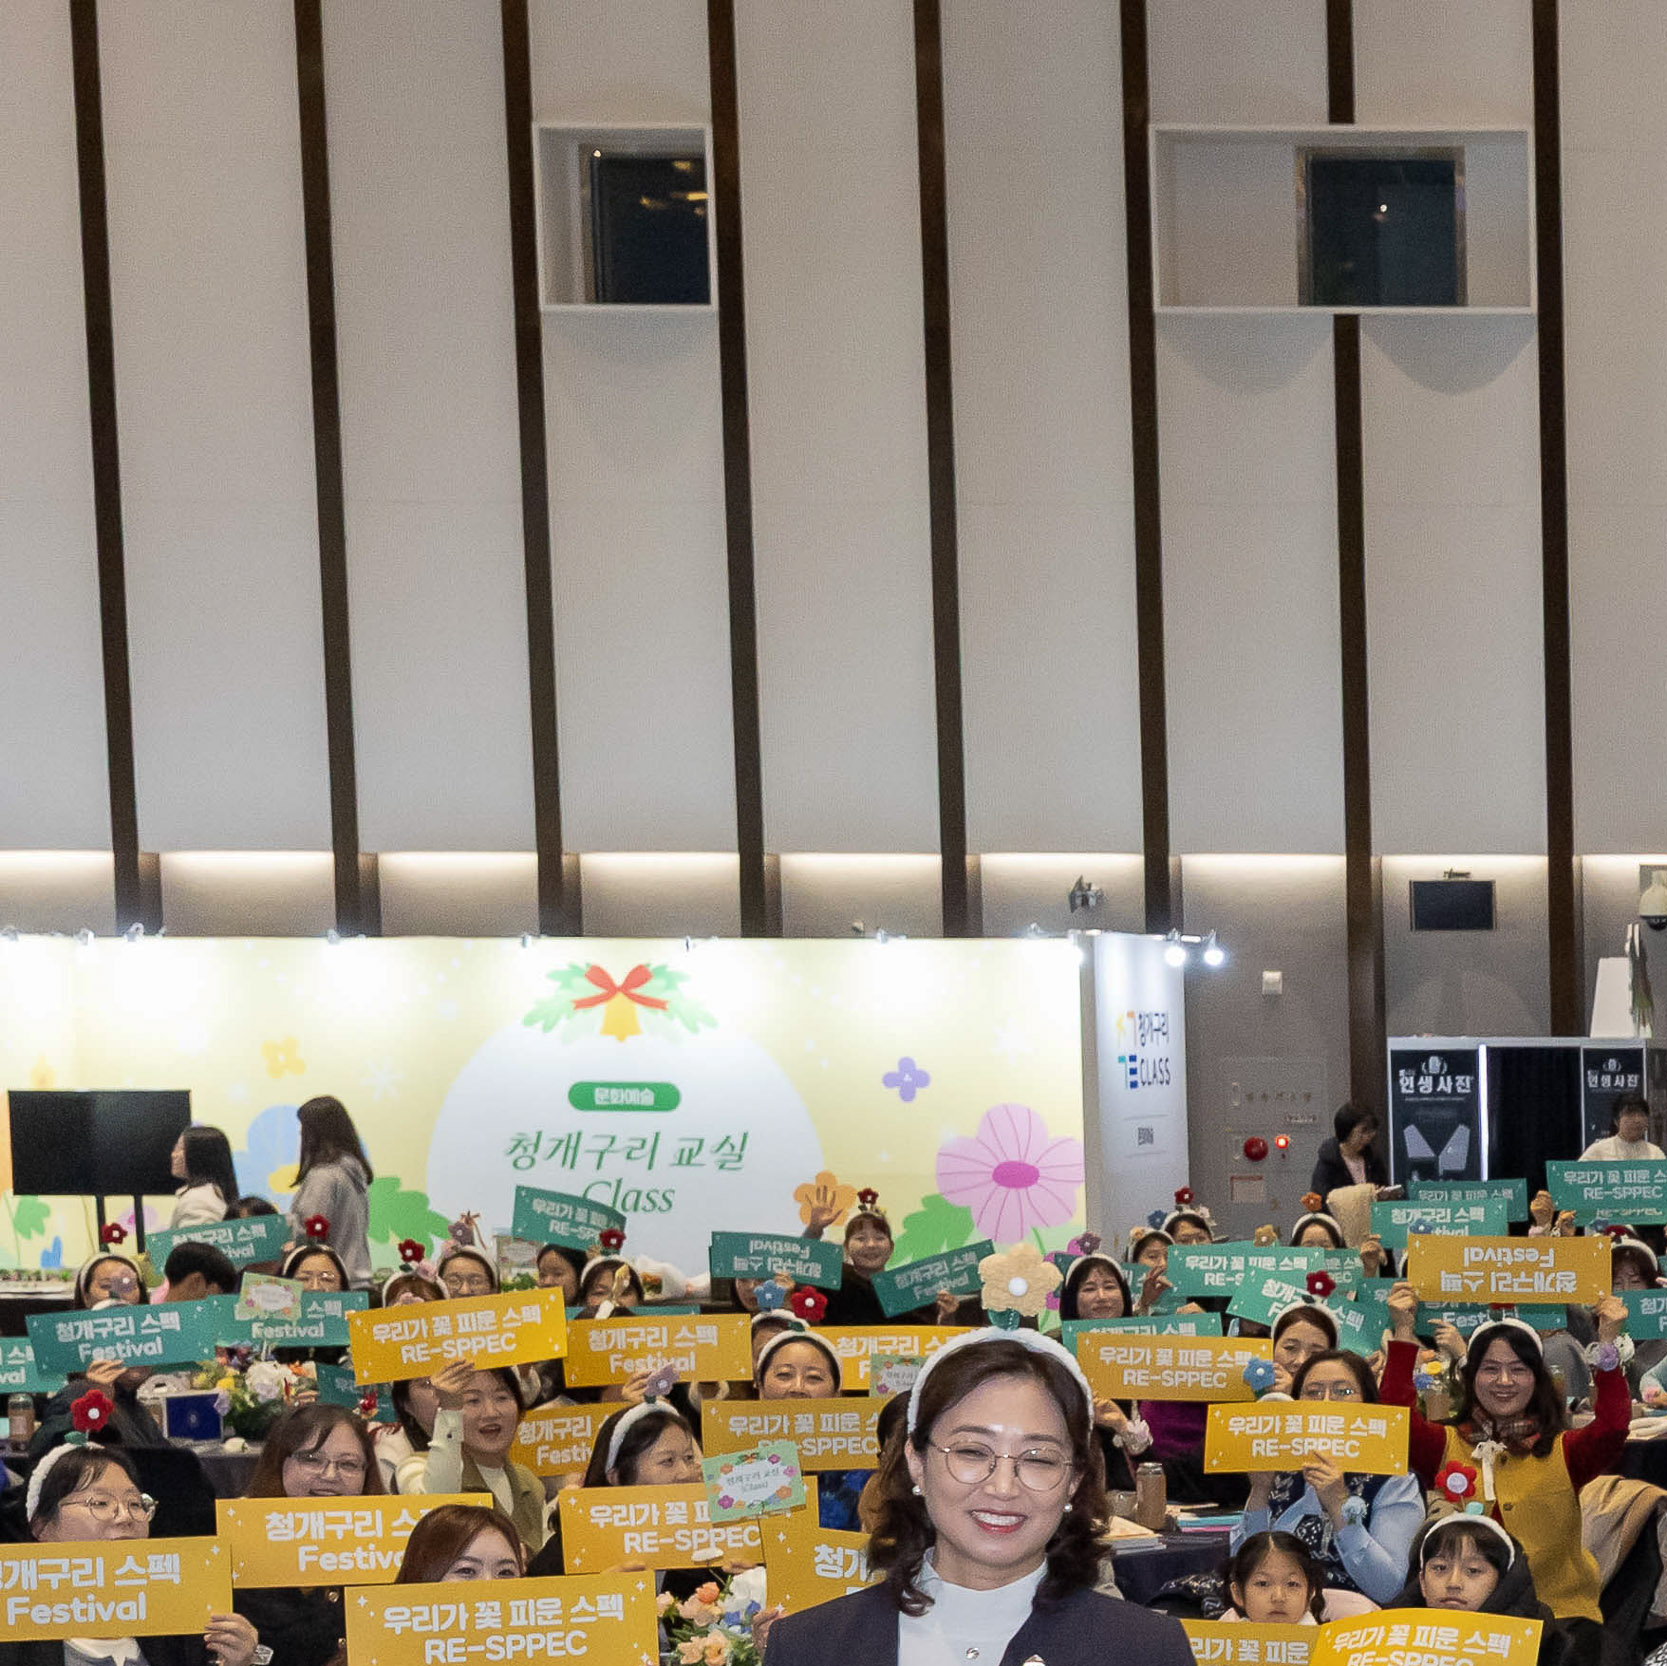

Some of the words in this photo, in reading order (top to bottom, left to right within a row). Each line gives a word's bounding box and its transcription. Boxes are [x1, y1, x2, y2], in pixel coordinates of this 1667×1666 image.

[1140, 1057, 1171, 1086] CLASS
[1400, 1075, 1472, 1094] 인생사진
[506, 1130, 660, 1171] 청개구리
[669, 1131, 748, 1171] 교실
[1564, 1171, 1603, 1184] 우리가
[1624, 1170, 1650, 1184] 피운
[582, 1177, 676, 1214] Class
[1584, 1185, 1663, 1199] RE-SPPEC
[1391, 1208, 1451, 1223] 청개구리
[1455, 1207, 1484, 1222] 스펙
[1185, 1256, 1228, 1270] 우리가
[1279, 1256, 1308, 1271] 스펙
[1463, 1247, 1555, 1268] Festival
[1440, 1271, 1484, 1292] 스펙
[1490, 1271, 1577, 1294] 청개구리
[307, 1300, 342, 1318] 스펙
[56, 1315, 134, 1341] 청개구리
[140, 1311, 181, 1334] 스펙
[252, 1322, 324, 1339] Festival
[373, 1317, 429, 1344] 우리가
[432, 1314, 452, 1337] 꽃
[456, 1310, 498, 1332] 피운
[502, 1305, 542, 1327] 스펙
[78, 1336, 163, 1362] Festival
[401, 1333, 517, 1364] RE-SPPEC
[589, 1327, 668, 1351] 청개구리
[674, 1325, 718, 1346] 스펙
[835, 1336, 919, 1357] 청개구리
[609, 1352, 695, 1372] Festival
[1099, 1346, 1151, 1366] 우리가
[1155, 1348, 1172, 1367] 꽃
[1178, 1348, 1212, 1368] 피운
[1217, 1350, 1252, 1368] 스펙
[1123, 1370, 1227, 1389] RE-SPPEC
[518, 1416, 591, 1444] 청개구리
[729, 1415, 789, 1436] 우리가
[794, 1414, 813, 1434] 꽃
[820, 1413, 860, 1433] 피운
[1228, 1417, 1280, 1435] 우리가
[1285, 1414, 1303, 1434] 꽃
[1307, 1415, 1344, 1435] 피운
[1349, 1417, 1386, 1437] 스펙
[1251, 1439, 1360, 1458] RE-SPPEC
[265, 1510, 383, 1541] 청개구리
[590, 1503, 659, 1528] 우리가
[665, 1501, 687, 1525] 꽃
[624, 1526, 762, 1553] RE-SPPEC
[115, 1553, 181, 1585] 스펙
[7, 1593, 147, 1625] Festival
[384, 1605, 468, 1634] 우리가
[475, 1601, 502, 1630] 꽃
[509, 1598, 563, 1626] 피운
[571, 1594, 624, 1622] 스펙
[424, 1631, 588, 1664] RE-SPPEC
[1238, 1638, 1259, 1662] 꽃
[1265, 1641, 1309, 1665] 피운
[1332, 1627, 1386, 1653] 우리가
[1387, 1624, 1409, 1646] 꽃
[1415, 1626, 1458, 1650] 피운
[1462, 1631, 1511, 1657] 스펙
